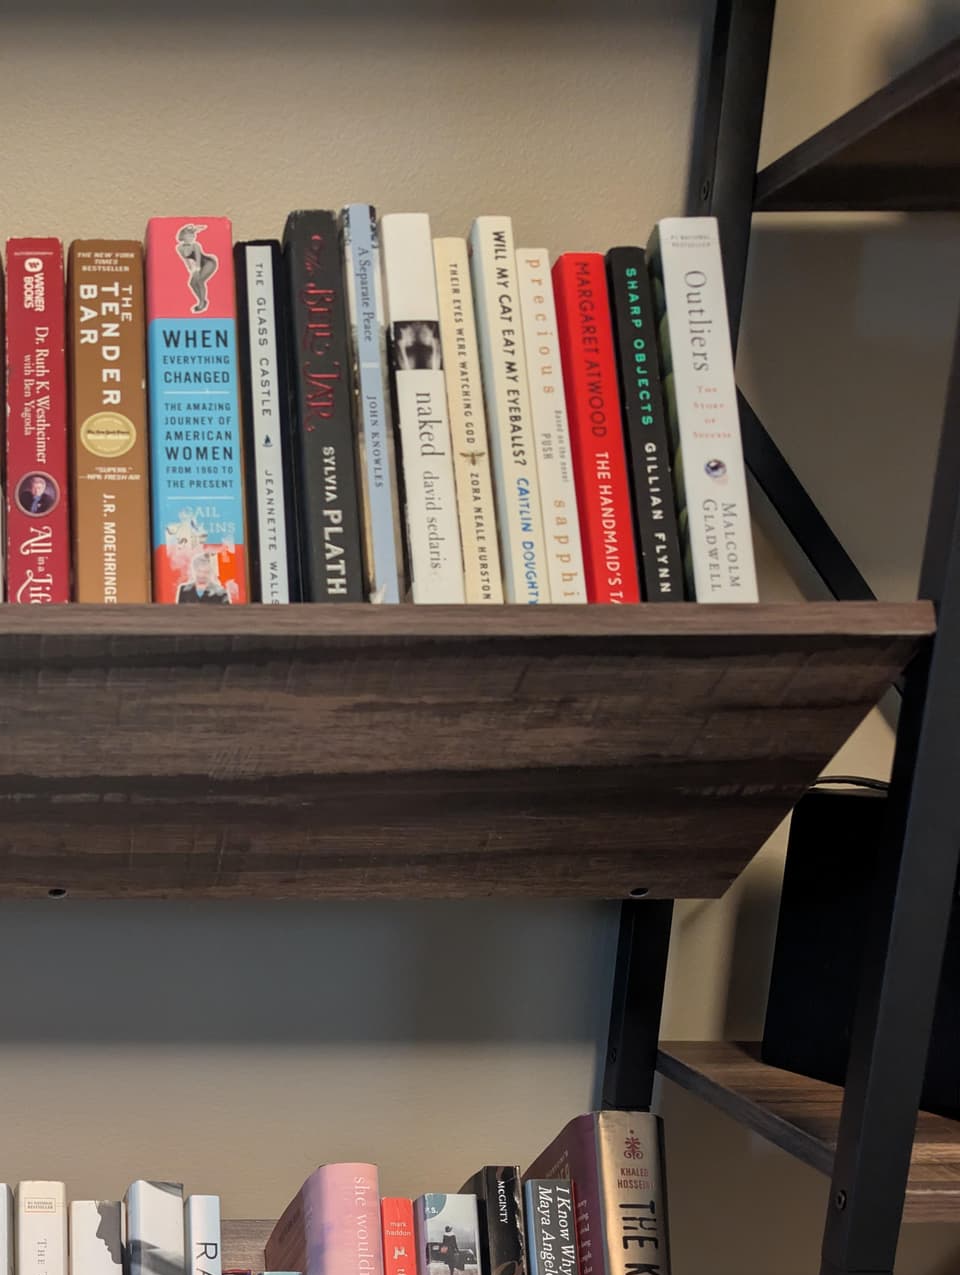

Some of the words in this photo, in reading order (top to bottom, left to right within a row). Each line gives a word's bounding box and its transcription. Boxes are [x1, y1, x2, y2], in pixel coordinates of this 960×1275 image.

[450, 264, 460, 294] THEIR
[80, 284, 99, 344] BAR
[121, 285, 133, 322] THE
[453, 299, 463, 323] EYES
[684, 270, 712, 372] Outliers
[101, 282, 121, 405] TENDER
[163, 330, 228, 348] WHEN
[456, 328, 466, 356] WERE
[24, 355, 35, 376] with
[163, 356, 230, 365] EVERYTHING
[24, 378, 35, 398] Ben
[164, 372, 230, 383] CHANGED
[459, 361, 472, 416] WATCHING
[21, 400, 36, 436] Yagoda
[415, 392, 446, 457] naked
[165, 431, 232, 441] AMERICAN
[465, 422, 475, 444] GOD
[166, 447, 233, 460] WOMEN
[168, 480, 186, 489] THE
[189, 480, 234, 489] PRESENT
[322, 446, 338, 502] SYLVIA
[516, 477, 533, 533] CAITLIN
[322, 510, 348, 595] PLATH
[620, 1168, 649, 1177] KHALED
[539, 1187, 553, 1225] Maya
[386, 1229, 411, 1237] haddon
